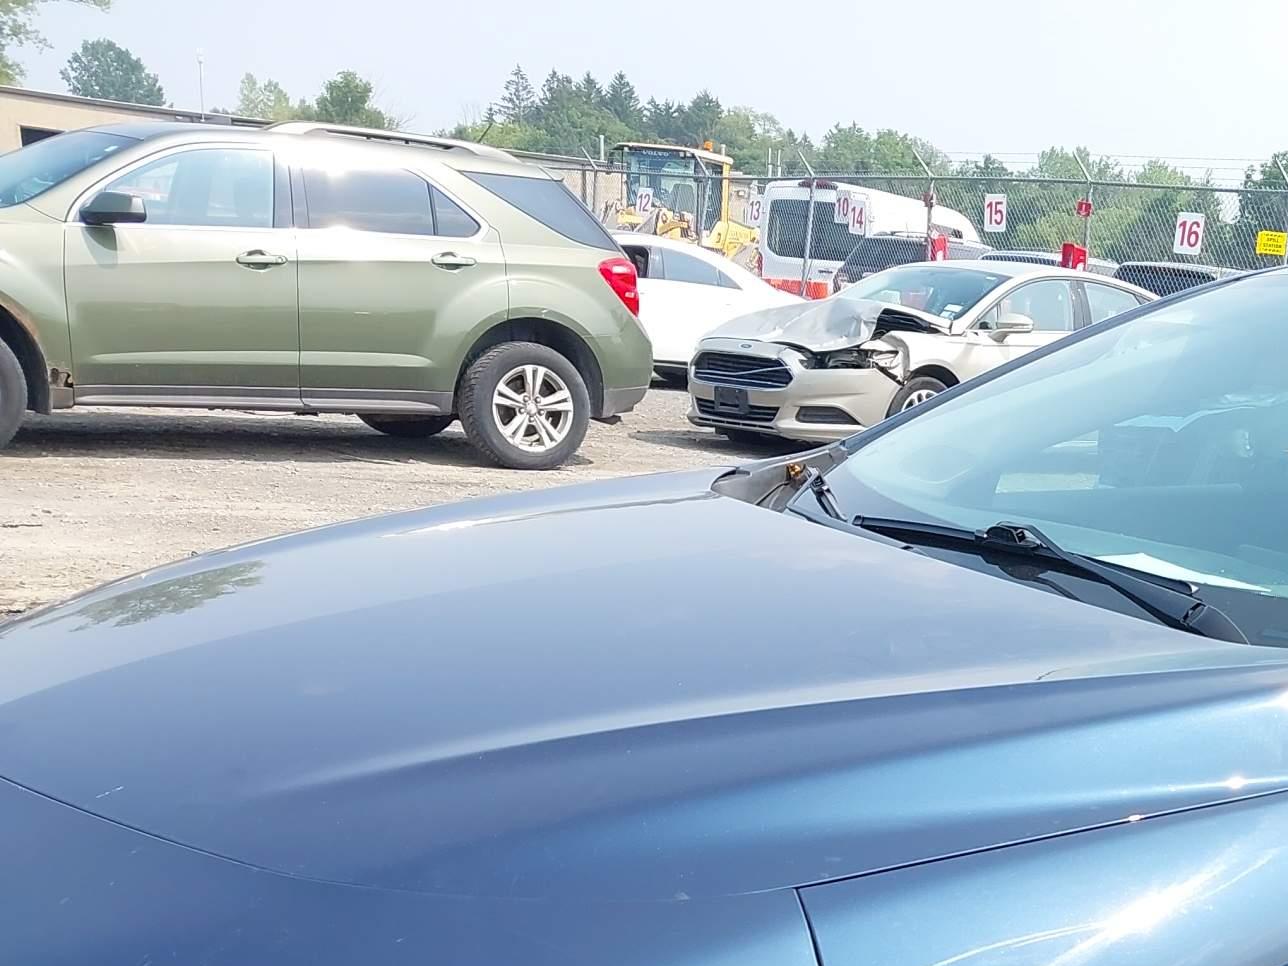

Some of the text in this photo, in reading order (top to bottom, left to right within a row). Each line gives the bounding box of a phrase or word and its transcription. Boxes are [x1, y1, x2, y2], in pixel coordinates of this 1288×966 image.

[637, 193, 651, 212] 12
[749, 200, 761, 221] 13
[837, 197, 849, 218] 10
[986, 201, 1004, 226] 15
[851, 205, 864, 230] 14
[1178, 220, 1201, 248] 16
